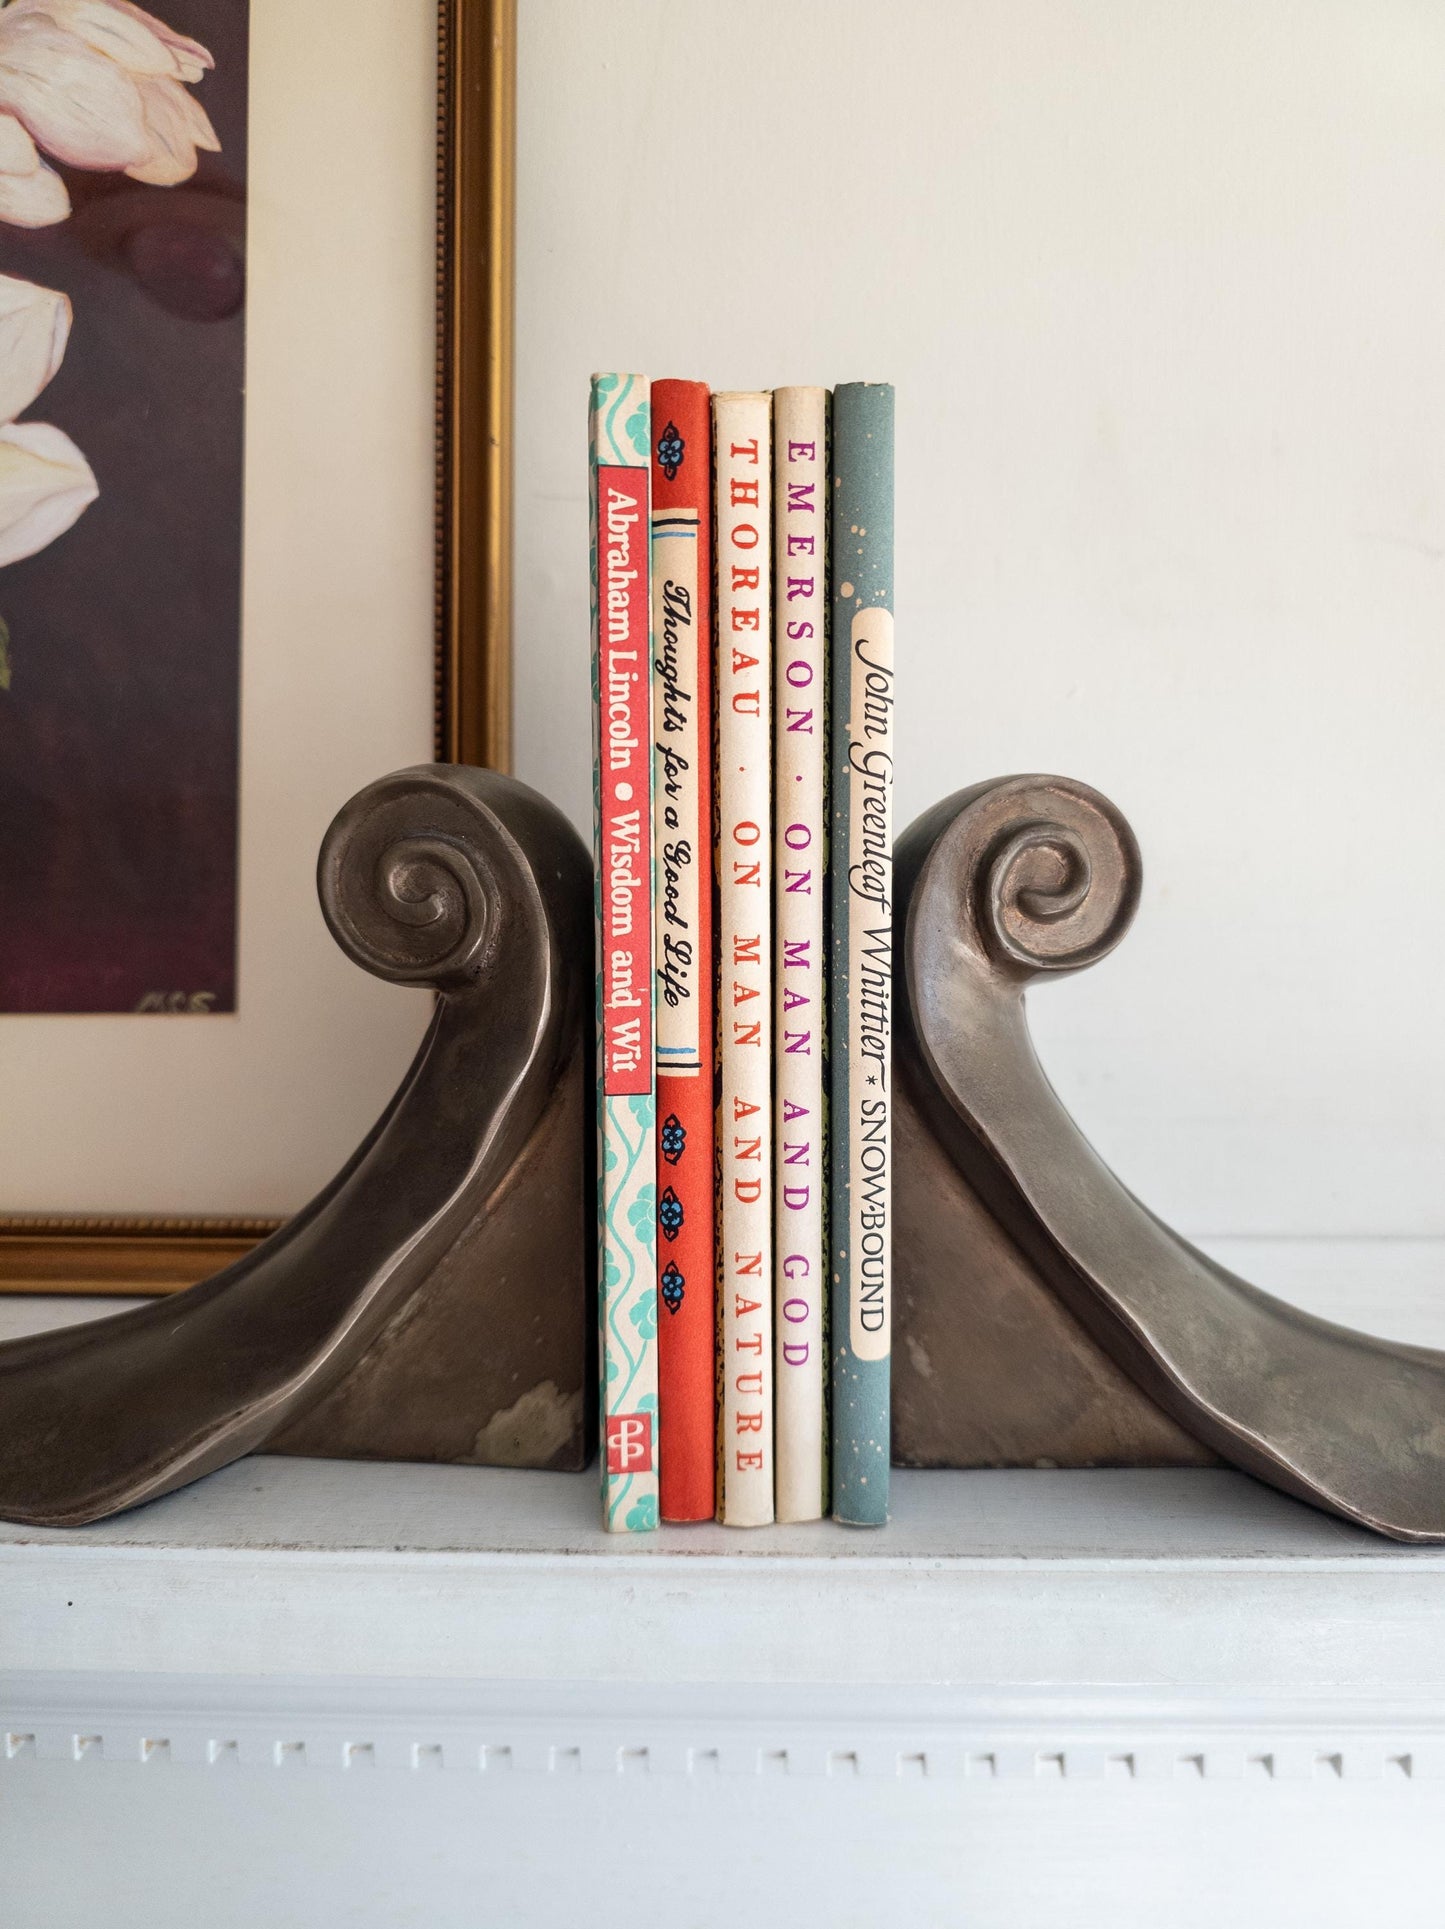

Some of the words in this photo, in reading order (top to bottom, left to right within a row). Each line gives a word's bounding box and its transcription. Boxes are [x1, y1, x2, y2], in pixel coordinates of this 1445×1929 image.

[607, 487, 639, 643] Abraham
[730, 439, 760, 717] THOREAU
[786, 440, 816, 735] EMERSON
[607, 649, 640, 769] Lincoln
[655, 579, 692, 732] Thoughts
[855, 639, 893, 740] John
[656, 740, 689, 803] for
[664, 806, 679, 829] a
[610, 810, 642, 936] Wisdom
[664, 839, 692, 930] Good
[733, 821, 761, 888] ON
[784, 823, 812, 895] ON
[848, 741, 893, 916] Greenleaf
[611, 951, 642, 1009] and
[657, 932, 692, 1009] Life
[733, 934, 761, 1048] MAN
[784, 940, 811, 1056] MAN
[860, 924, 892, 1092] Whittier
[611, 1017, 642, 1073] Wit
[733, 1096, 761, 1204] AND
[783, 1099, 811, 1211] AND
[734, 1252, 764, 1472] NATURE
[783, 1254, 810, 1367] GOD
